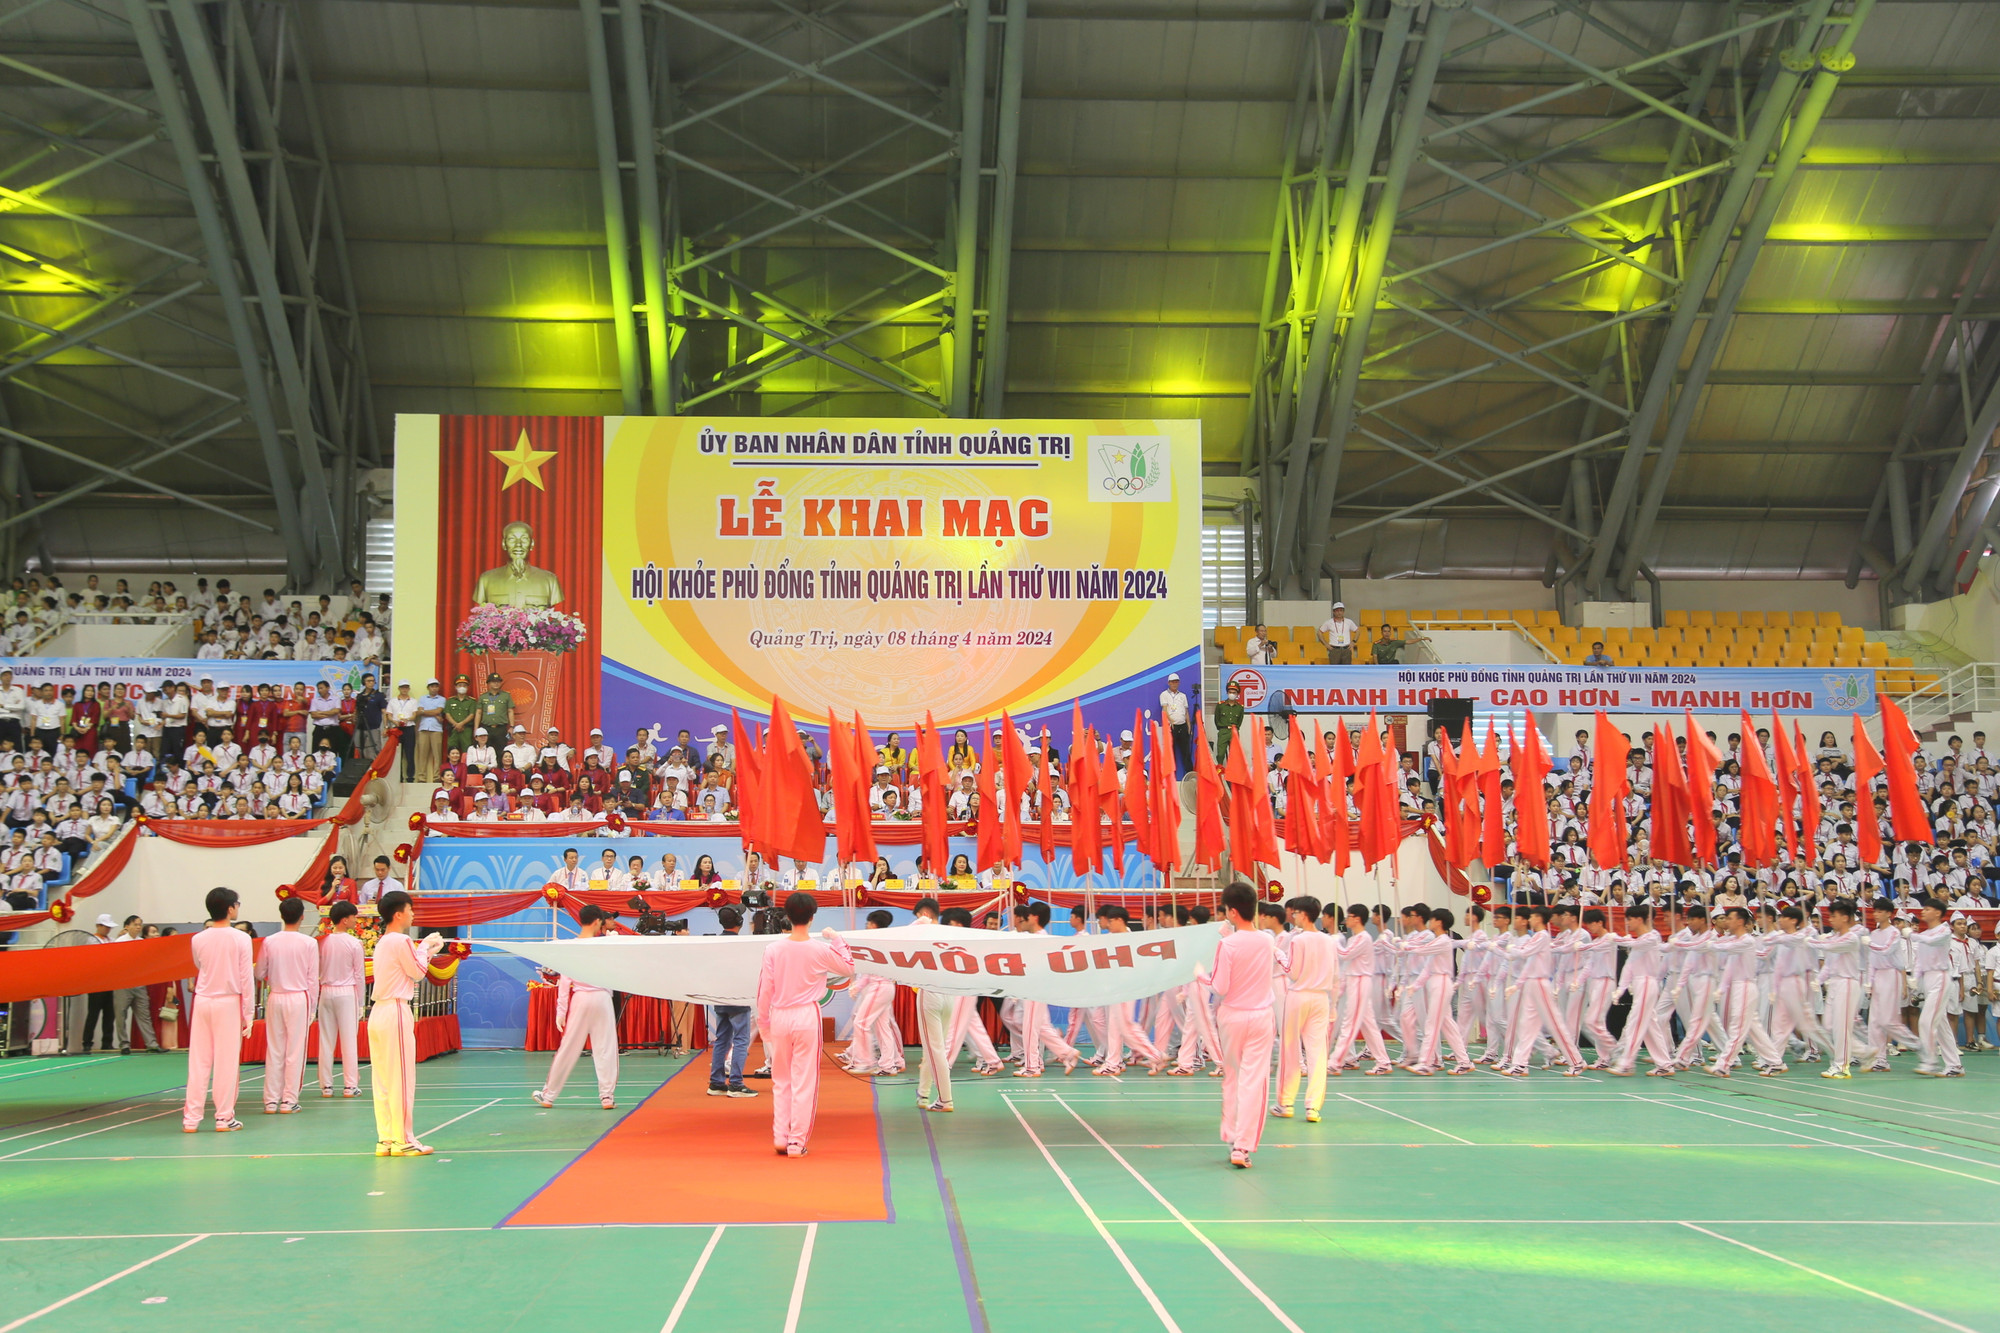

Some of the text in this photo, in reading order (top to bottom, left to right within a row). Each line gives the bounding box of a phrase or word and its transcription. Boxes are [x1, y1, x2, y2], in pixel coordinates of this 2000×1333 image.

[700, 428, 1071, 459] ỦY BAN NHÂN DÂN TỈNH QUẢNG TRỊ
[719, 480, 1049, 548] LỄ KHAI MẠC
[631, 558, 1168, 606] HỘI KHỎE PHÙ ĐỔNG TỈNH QUẢNG TRỊ LẦN THỨ VII NĂM 2024
[749, 628, 1053, 651] Quảng Trị, ngày 08 tháng 4 năm 2024
[118, 667, 133, 677] VII
[165, 667, 192, 677] 2024
[1398, 668, 1697, 686] HỘI KHỎE PHÙ ĐỔNG TỈNH QUẢNG TRỊ LẦN THỨ VII NĂM 2024
[1284, 688, 1388, 706] NHANH
[1490, 688, 1548, 707] CAO
[1558, 687, 1620, 707] HƠN
[1651, 689, 1741, 711] MẠNH
[1750, 689, 1813, 709] HƠN
